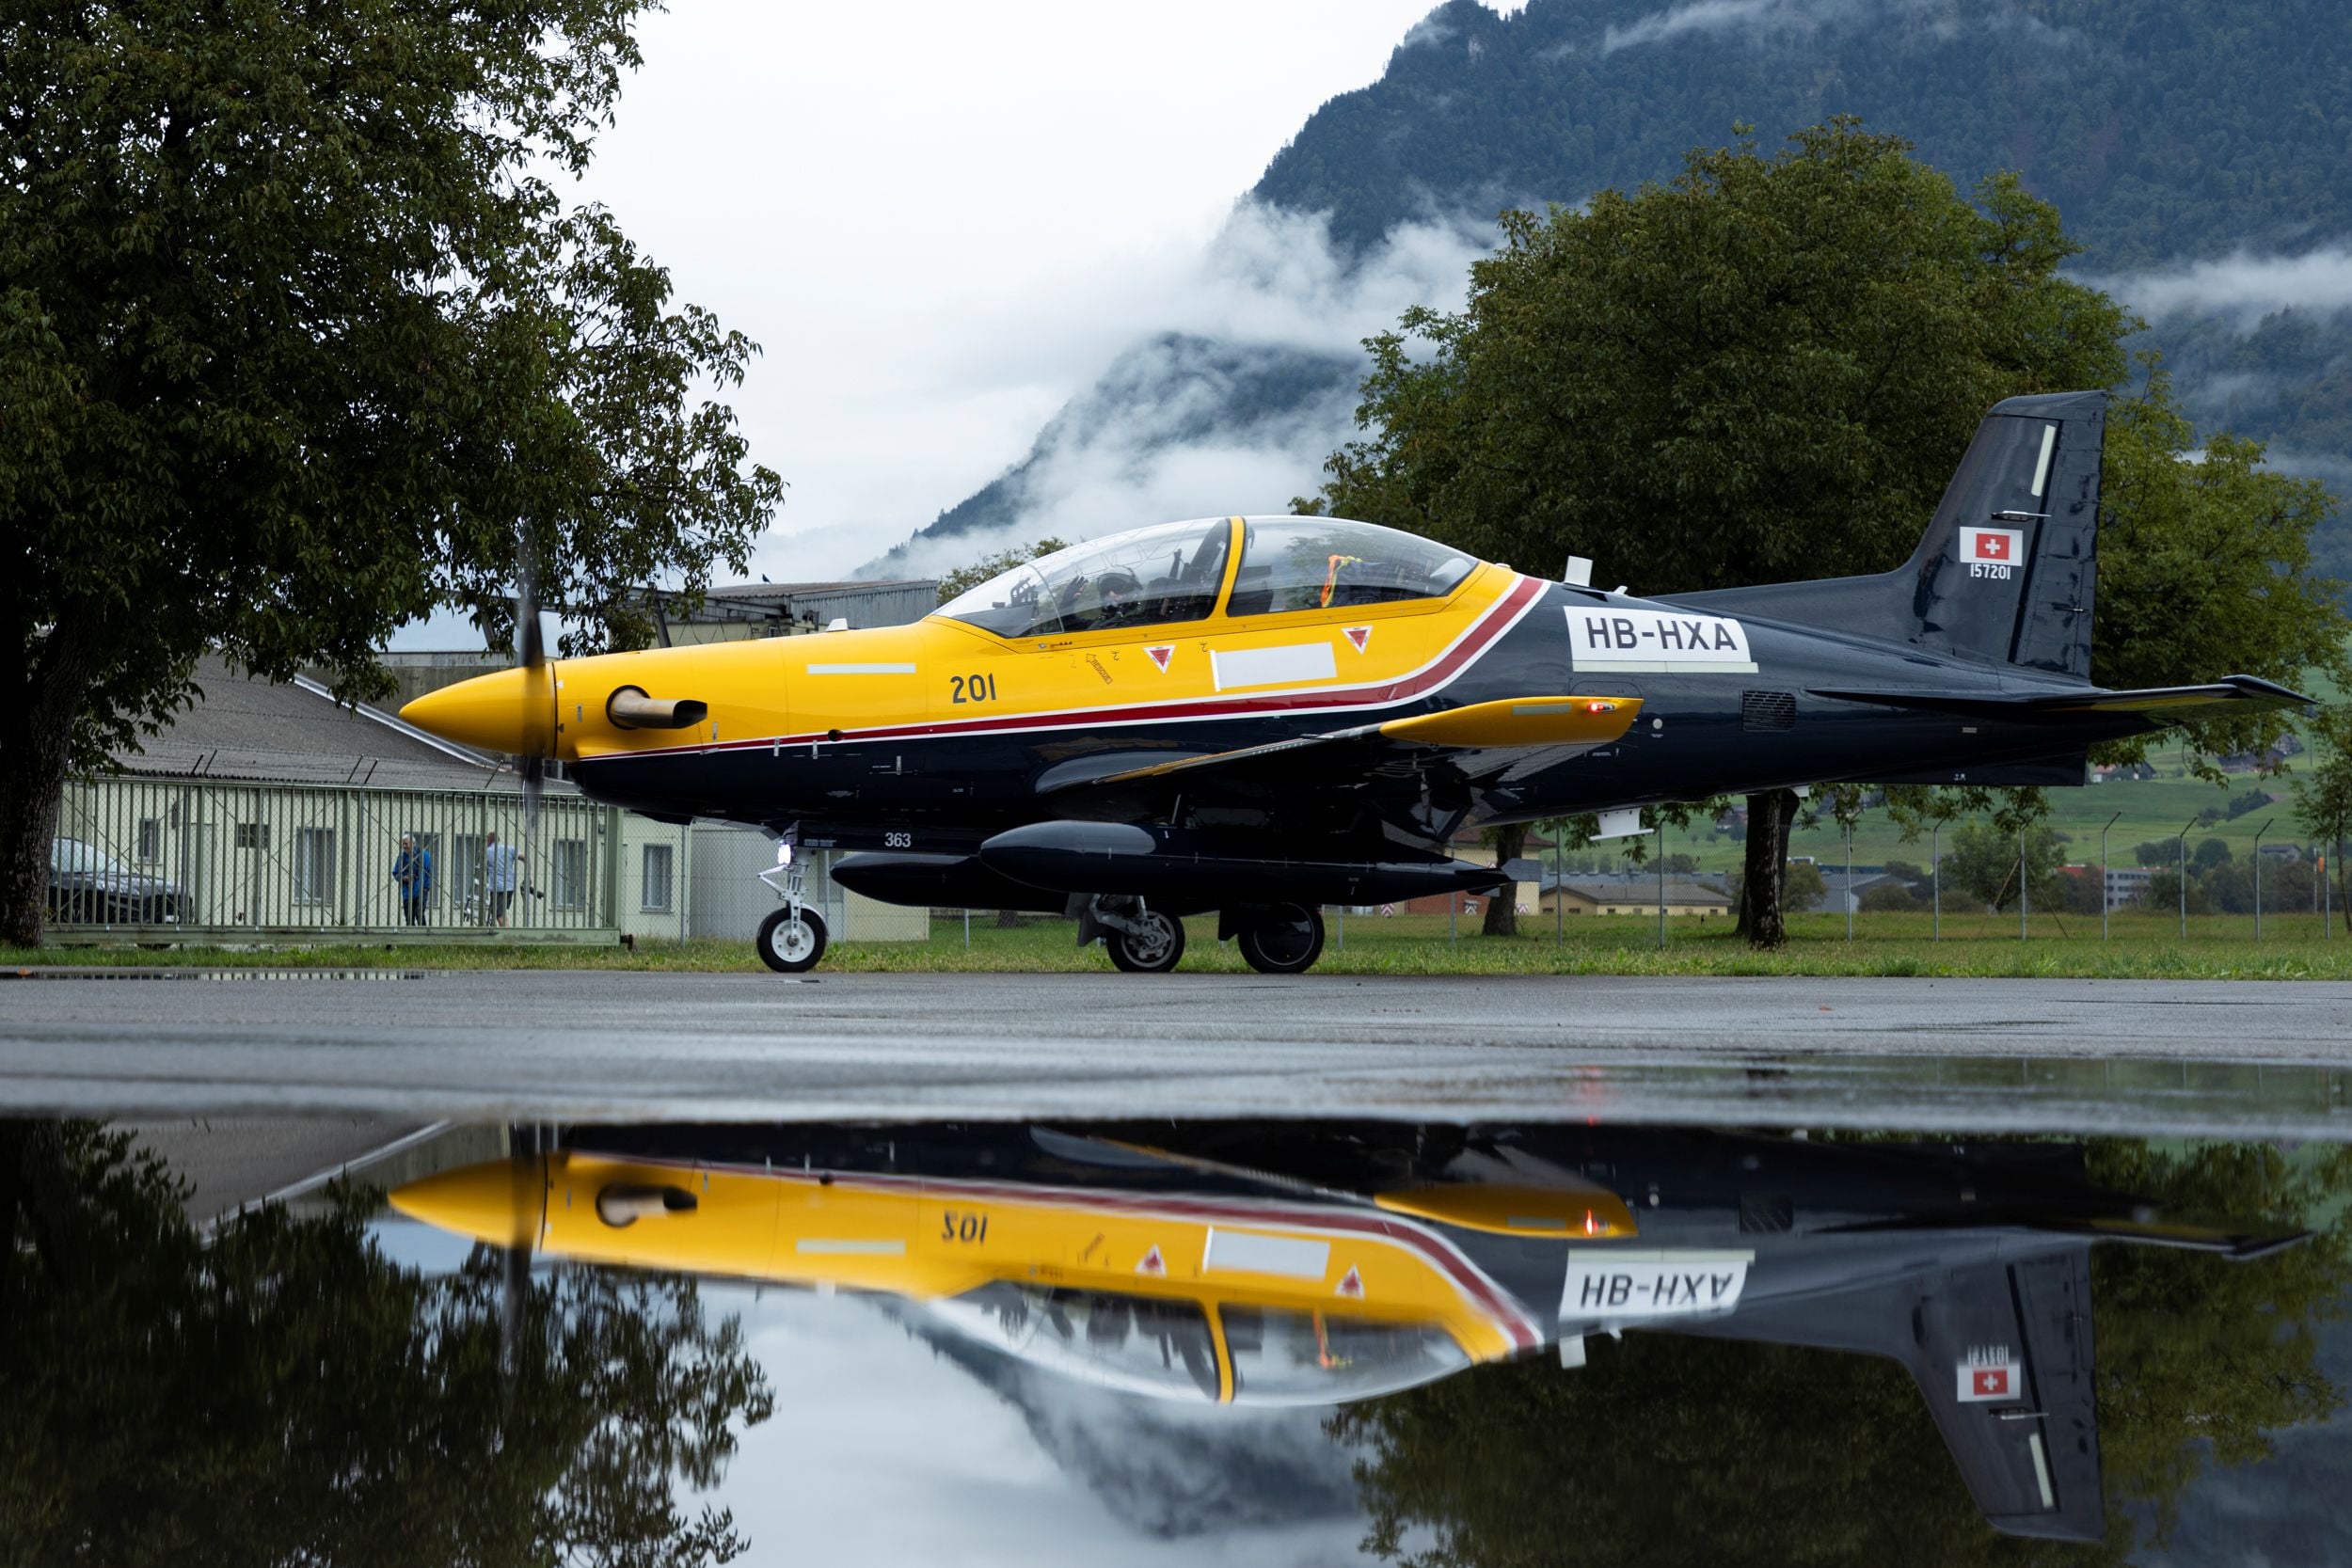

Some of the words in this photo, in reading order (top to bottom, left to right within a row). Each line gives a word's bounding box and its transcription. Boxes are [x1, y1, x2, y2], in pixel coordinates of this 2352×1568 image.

[1970, 563, 2011, 580] 157201
[1585, 617, 1738, 651] HB-HXA
[949, 673, 996, 704] 201
[884, 832, 912, 847] 363
